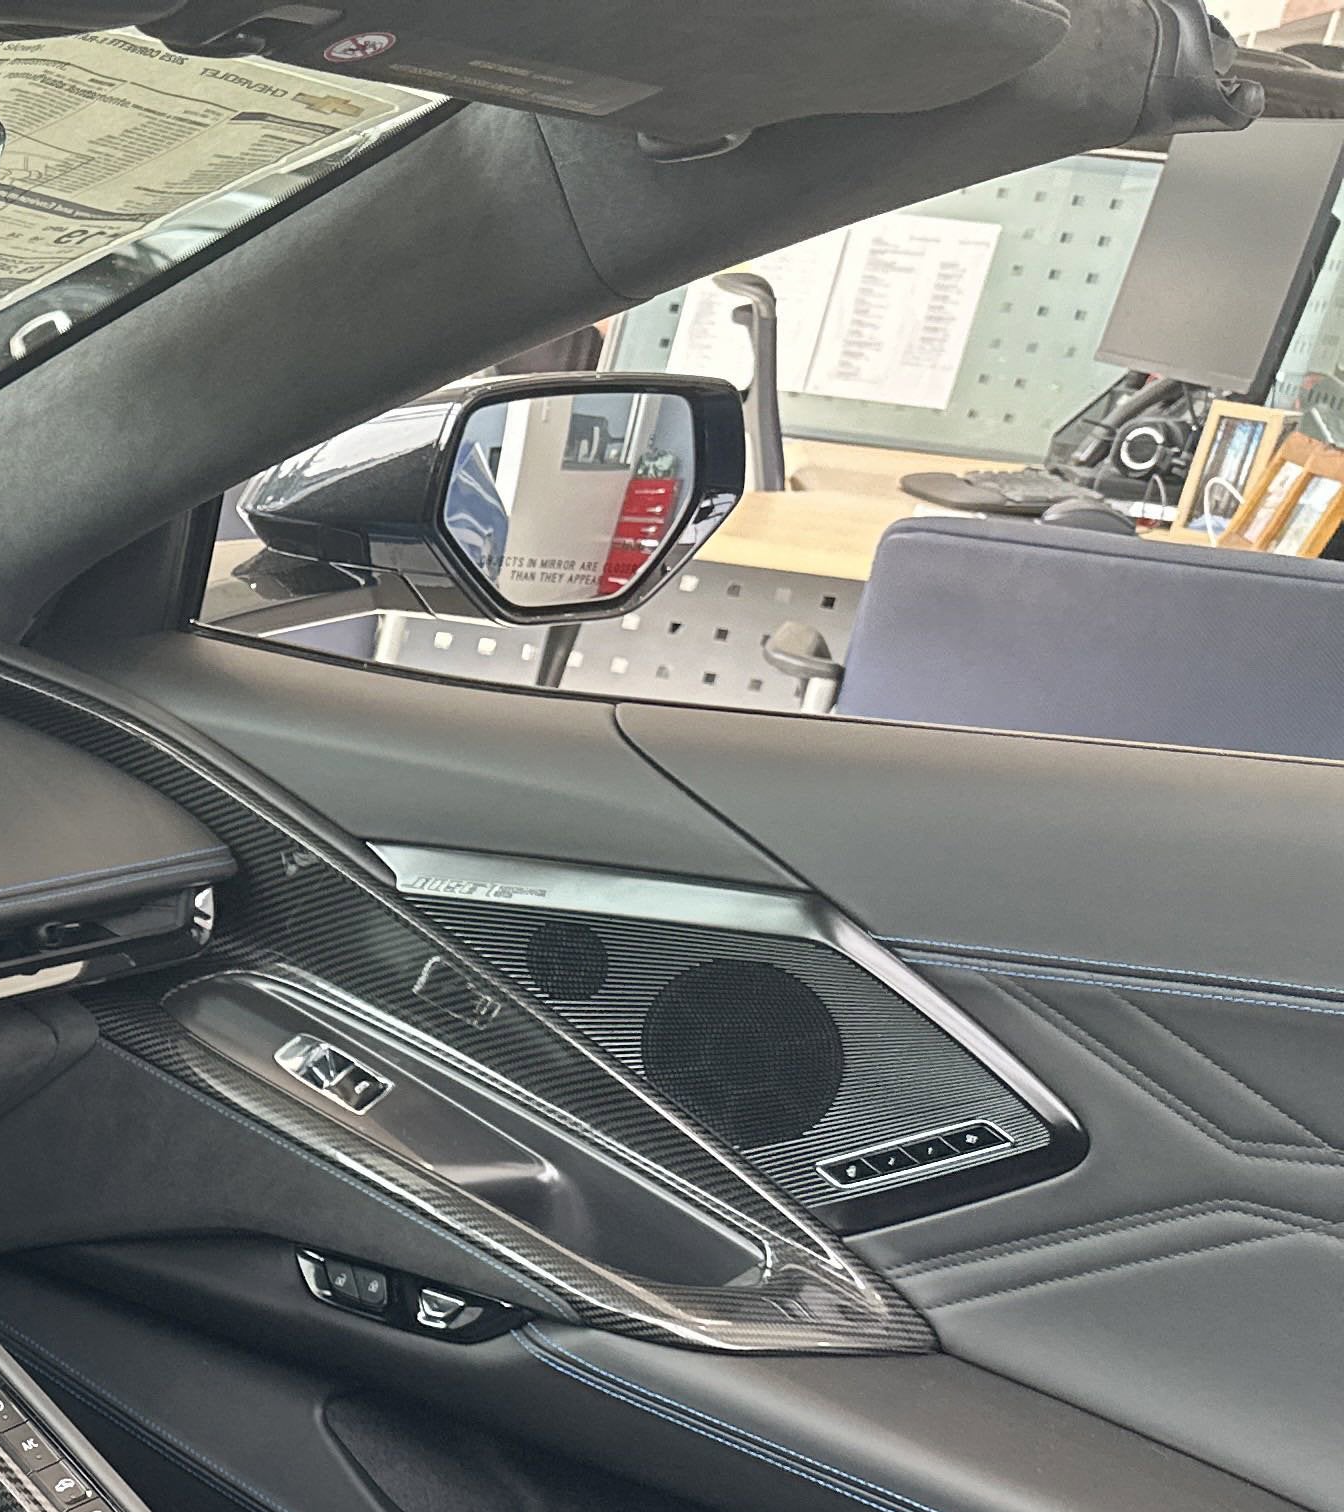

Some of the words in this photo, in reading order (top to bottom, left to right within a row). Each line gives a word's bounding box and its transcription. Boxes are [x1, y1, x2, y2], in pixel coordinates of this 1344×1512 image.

[526, 557, 538, 569] IN
[539, 558, 576, 571] MIRROR
[578, 560, 600, 573] ARE
[511, 569, 537, 582] THAN
[539, 571, 563, 584] THEY
[21, 1438, 39, 1451] A/C
